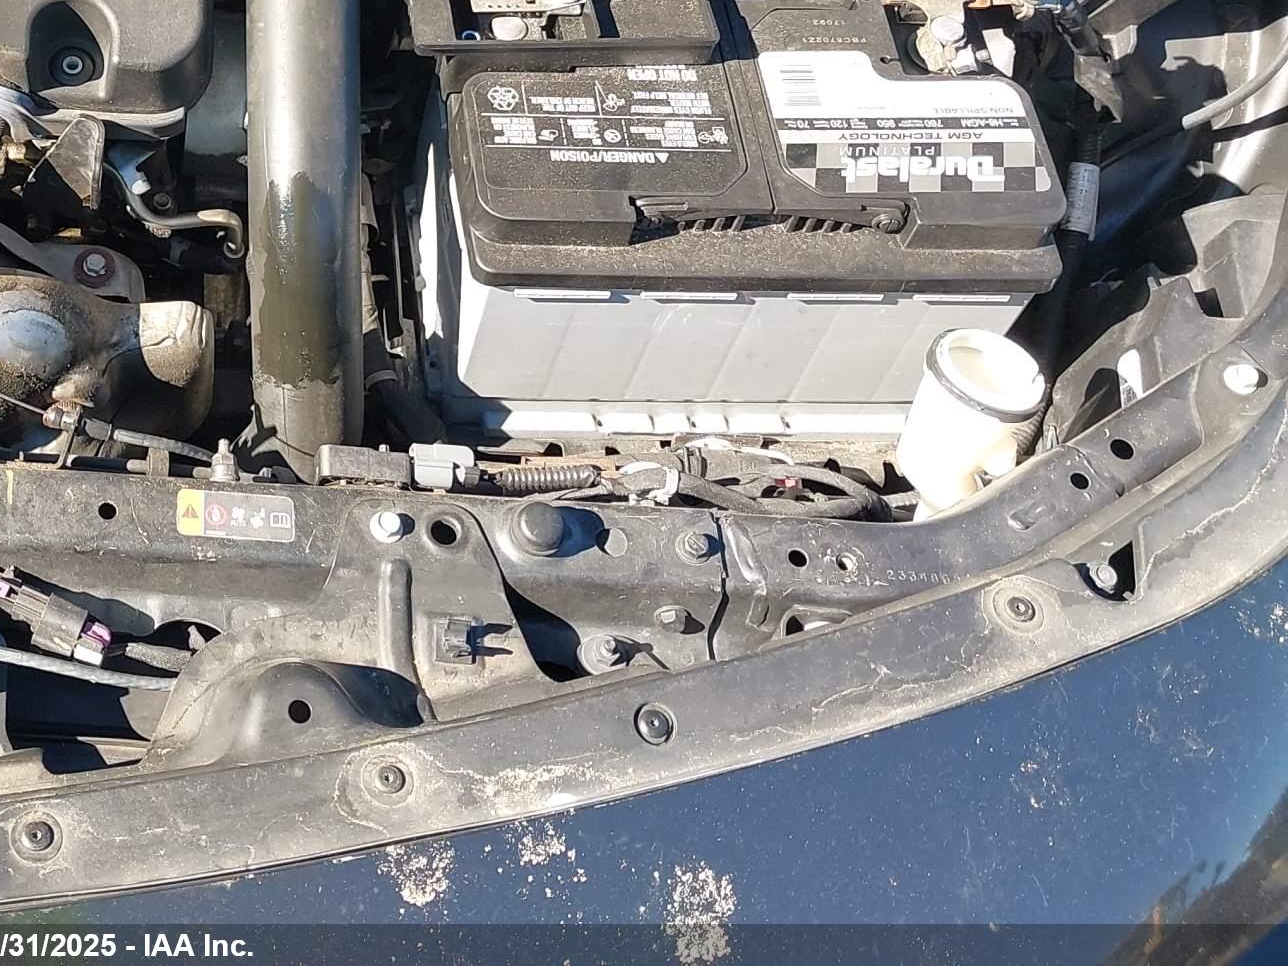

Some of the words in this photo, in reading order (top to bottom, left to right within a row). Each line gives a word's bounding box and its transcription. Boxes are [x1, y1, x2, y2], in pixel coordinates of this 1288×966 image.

[657, 69, 681, 81] NOT
[797, 119, 811, 129] 70
[830, 119, 848, 129] 120
[838, 131, 943, 141] TECHNOLOGY
[947, 131, 983, 140] AGM
[549, 149, 656, 164] DANGER/POISON
[838, 145, 935, 157] PLATINUM
[840, 155, 1006, 183] Duralast
